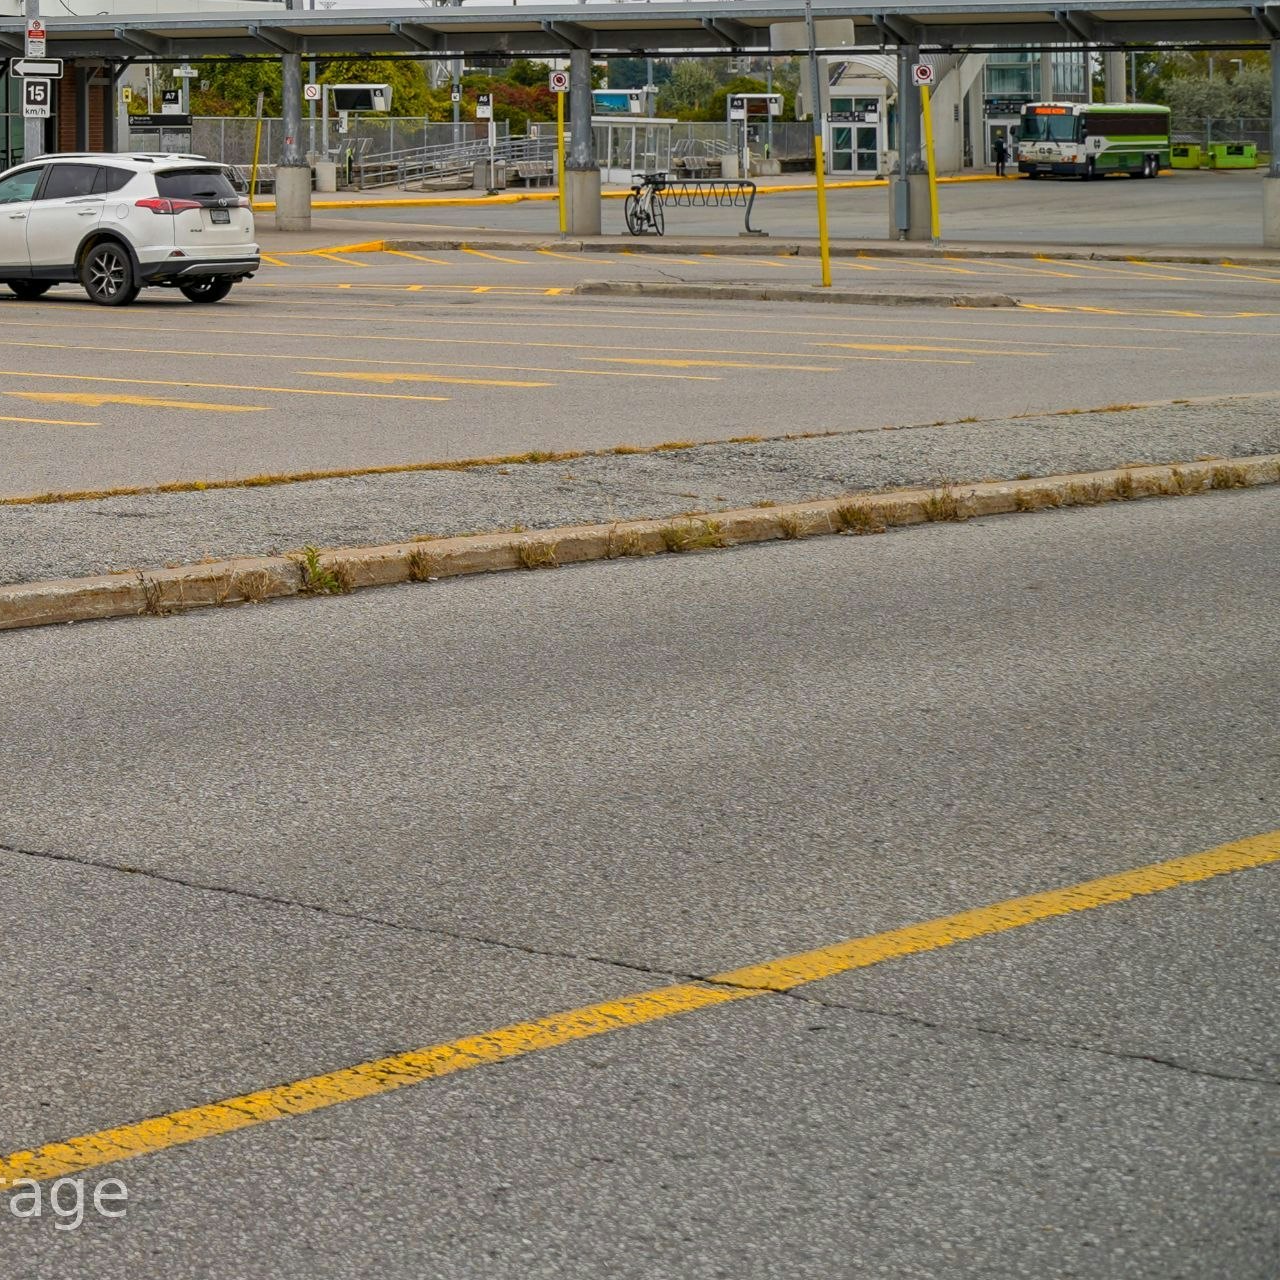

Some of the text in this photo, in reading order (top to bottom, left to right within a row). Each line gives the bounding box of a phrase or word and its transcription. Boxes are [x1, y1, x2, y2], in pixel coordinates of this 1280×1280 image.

[27, 85, 45, 102] 15
[164, 92, 176, 100] A7
[25, 107, 46, 116] km/h
